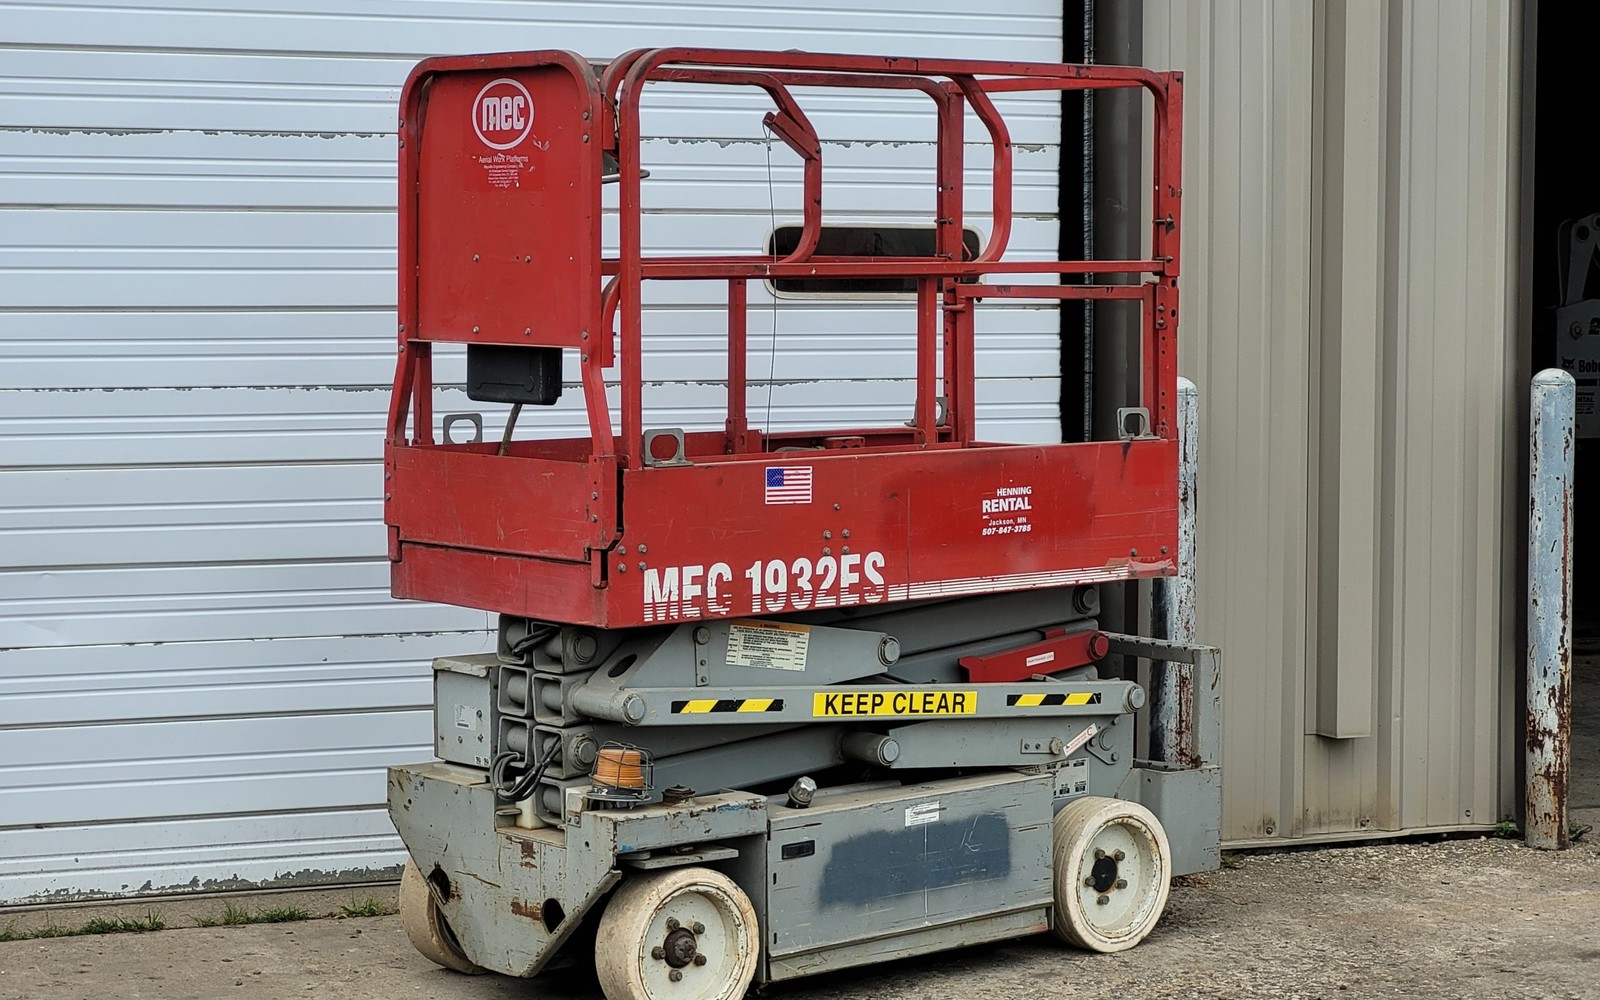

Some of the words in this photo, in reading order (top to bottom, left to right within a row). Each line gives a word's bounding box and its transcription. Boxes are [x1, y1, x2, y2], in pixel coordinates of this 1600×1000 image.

[997, 486, 1032, 497] HENNING
[982, 497, 1032, 513] RENTAL
[989, 518, 1015, 526] Jackson,
[643, 562, 733, 622] MEC
[745, 551, 885, 613] 1932ES
[825, 693, 884, 715] KEEP
[893, 692, 966, 714] CLEAR
